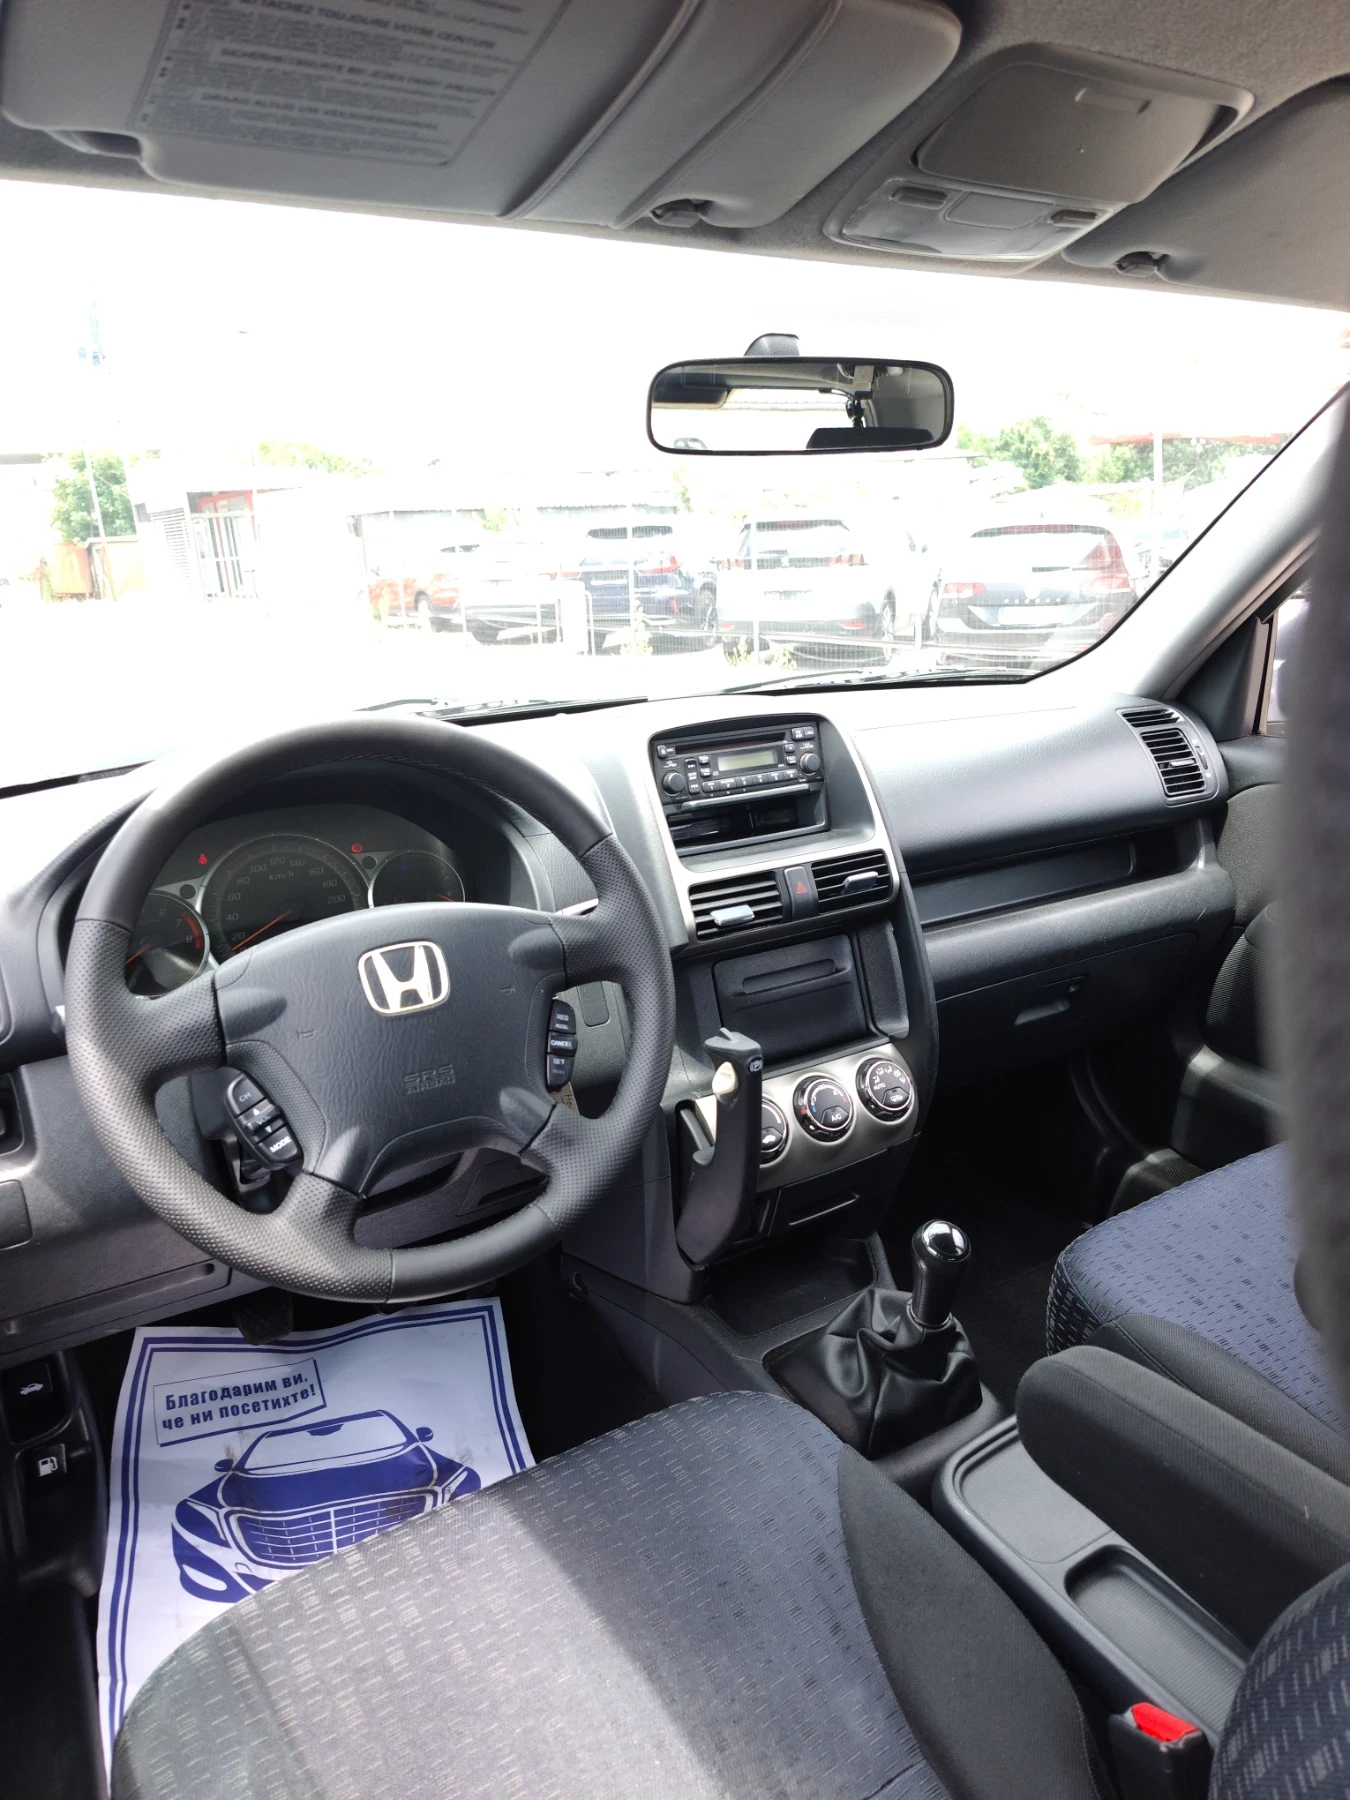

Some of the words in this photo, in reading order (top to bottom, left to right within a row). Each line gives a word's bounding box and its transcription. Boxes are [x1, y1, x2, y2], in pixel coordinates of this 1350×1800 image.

[270, 857, 286, 866] 120
[289, 859, 305, 868] 140
[251, 864, 267, 873] 100
[308, 867, 324, 877] 160
[269, 870, 294, 881] km/h
[237, 877, 250, 886] 80
[322, 879, 338, 889] 180
[228, 893, 241, 902] 60
[327, 894, 346, 905] 200
[226, 912, 240, 922] 40
[232, 931, 246, 941] 20
[550, 1039, 572, 1047] CANCEL
[404, 1064, 454, 1083] SRS
[406, 1076, 456, 1095] AIRBAG
[239, 1092, 251, 1102] CH
[269, 1135, 292, 1153] MODE
[165, 1379, 277, 1411] Благодарим
[162, 1416, 184, 1430] че
[190, 1409, 213, 1425] ни
[219, 1383, 316, 1419] посетихте!
